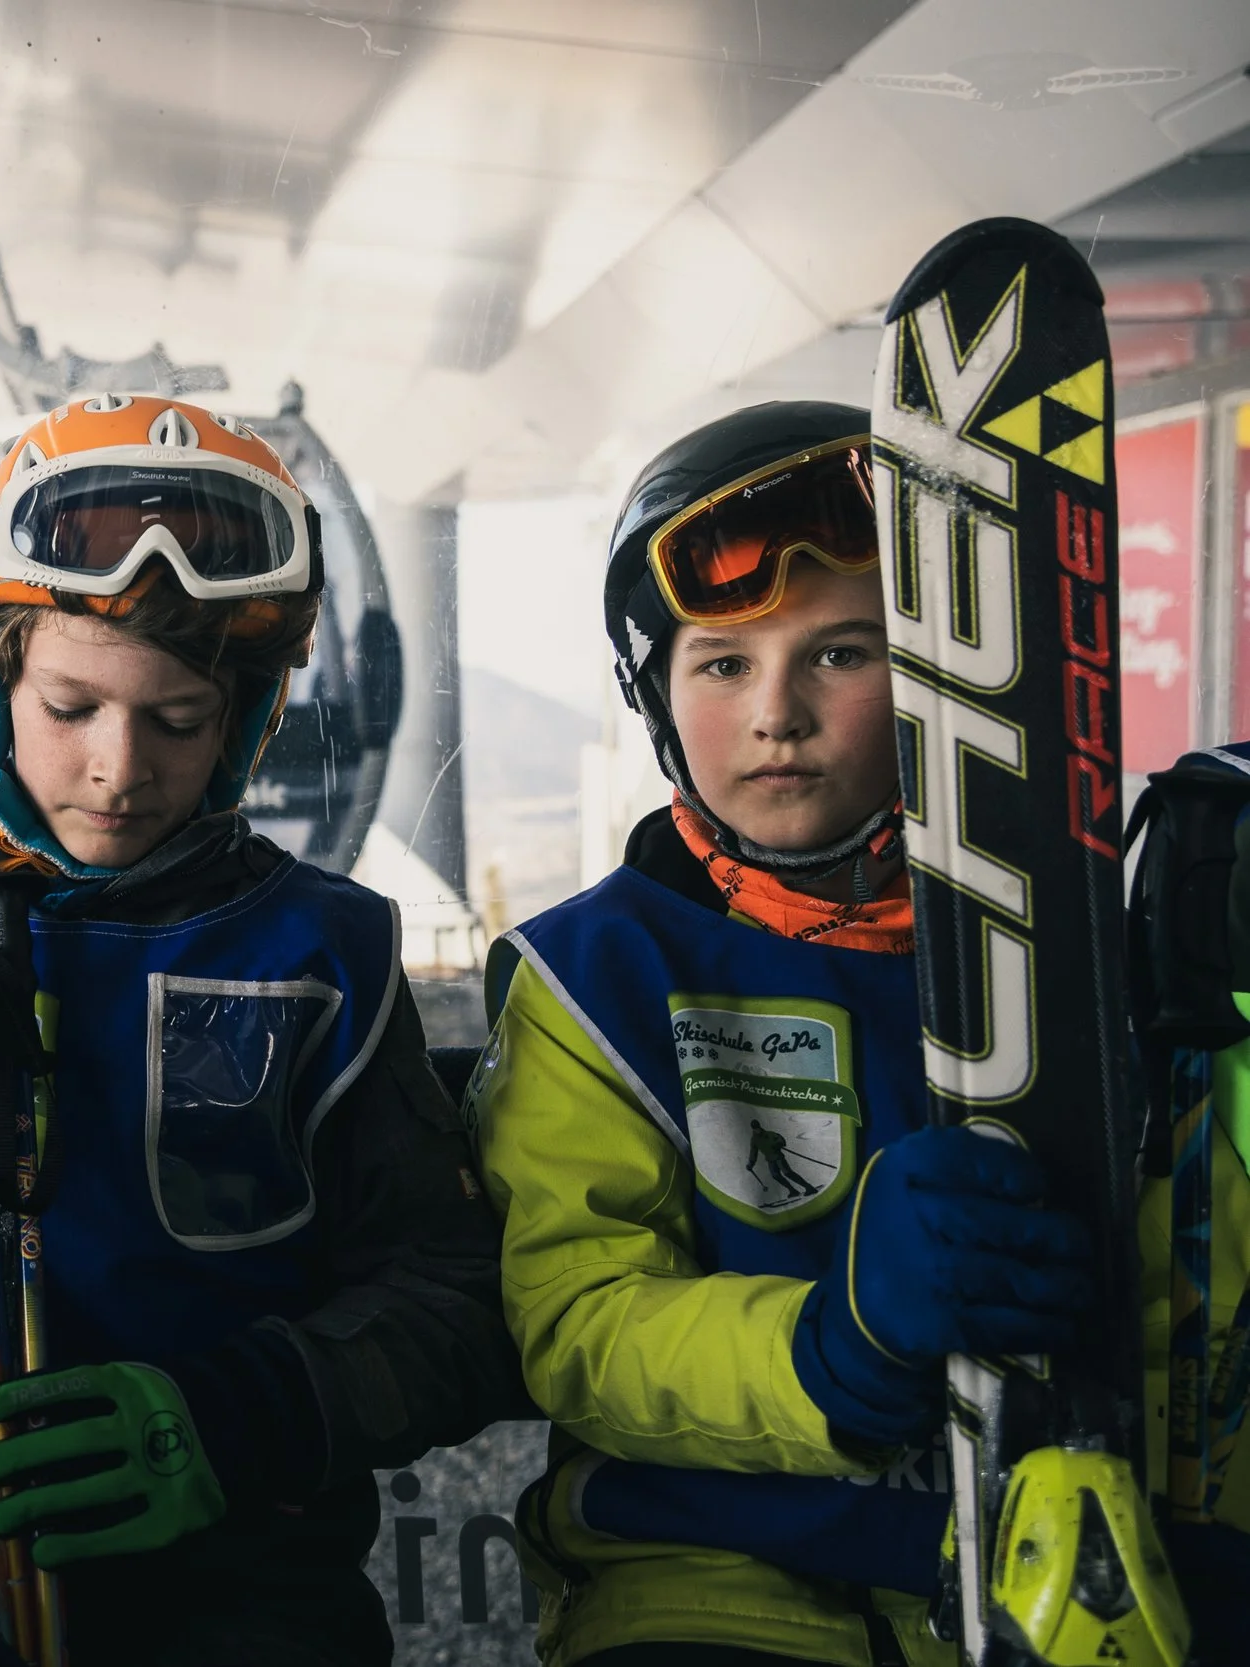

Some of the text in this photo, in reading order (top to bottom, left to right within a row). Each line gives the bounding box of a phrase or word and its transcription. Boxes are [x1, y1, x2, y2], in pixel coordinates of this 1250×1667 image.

[1056, 490, 1119, 861] RACE
[673, 1020, 822, 1062] Skischule GaPa
[684, 1077, 827, 1103] Garmisch-Partenkirchen
